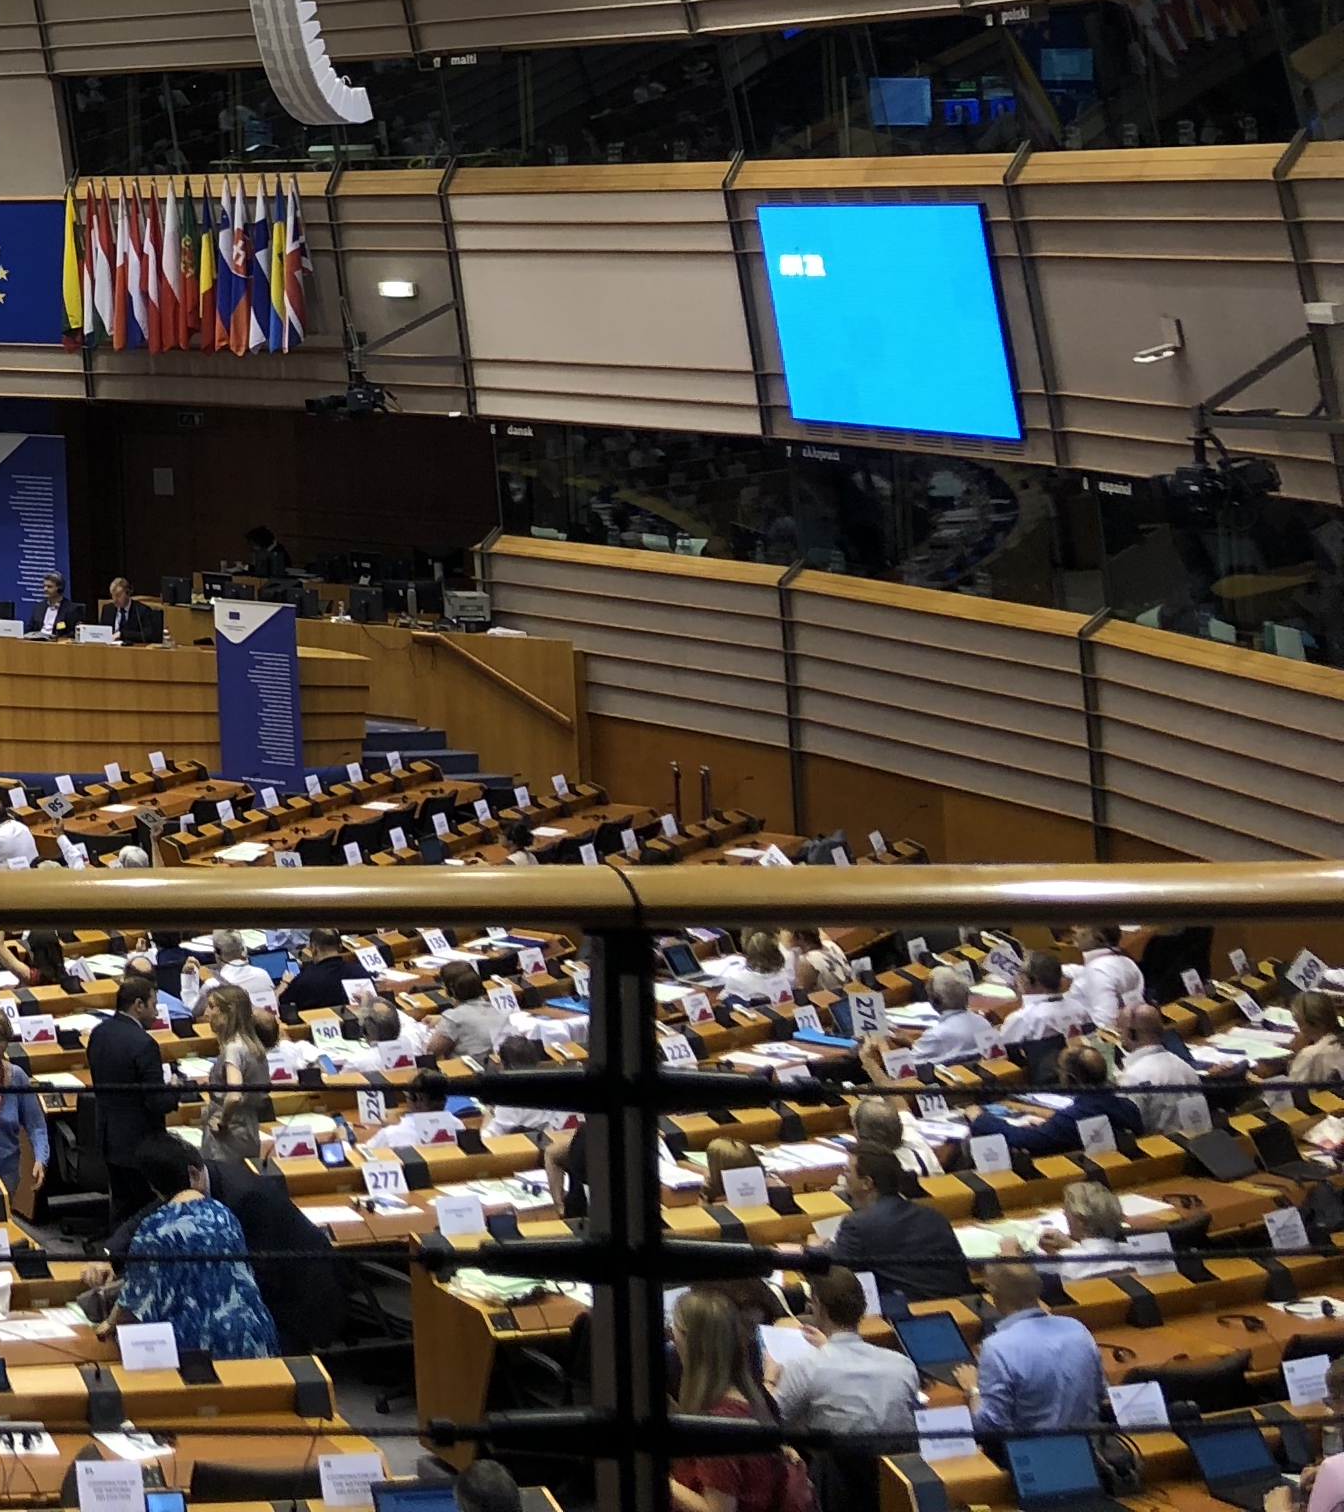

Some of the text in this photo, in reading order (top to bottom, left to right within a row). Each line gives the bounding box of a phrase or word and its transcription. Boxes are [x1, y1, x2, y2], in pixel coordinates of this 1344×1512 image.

[1001, 7, 1031, 26] polski
[450, 54, 477, 66] malti
[506, 424, 533, 438] dansk
[48, 798, 64, 812] 58
[428, 934, 447, 949] 135
[361, 953, 382, 967] 136
[493, 994, 516, 1010] 178
[855, 995, 878, 1032] 274
[666, 1044, 692, 1060] 223
[368, 1171, 400, 1189] 277
